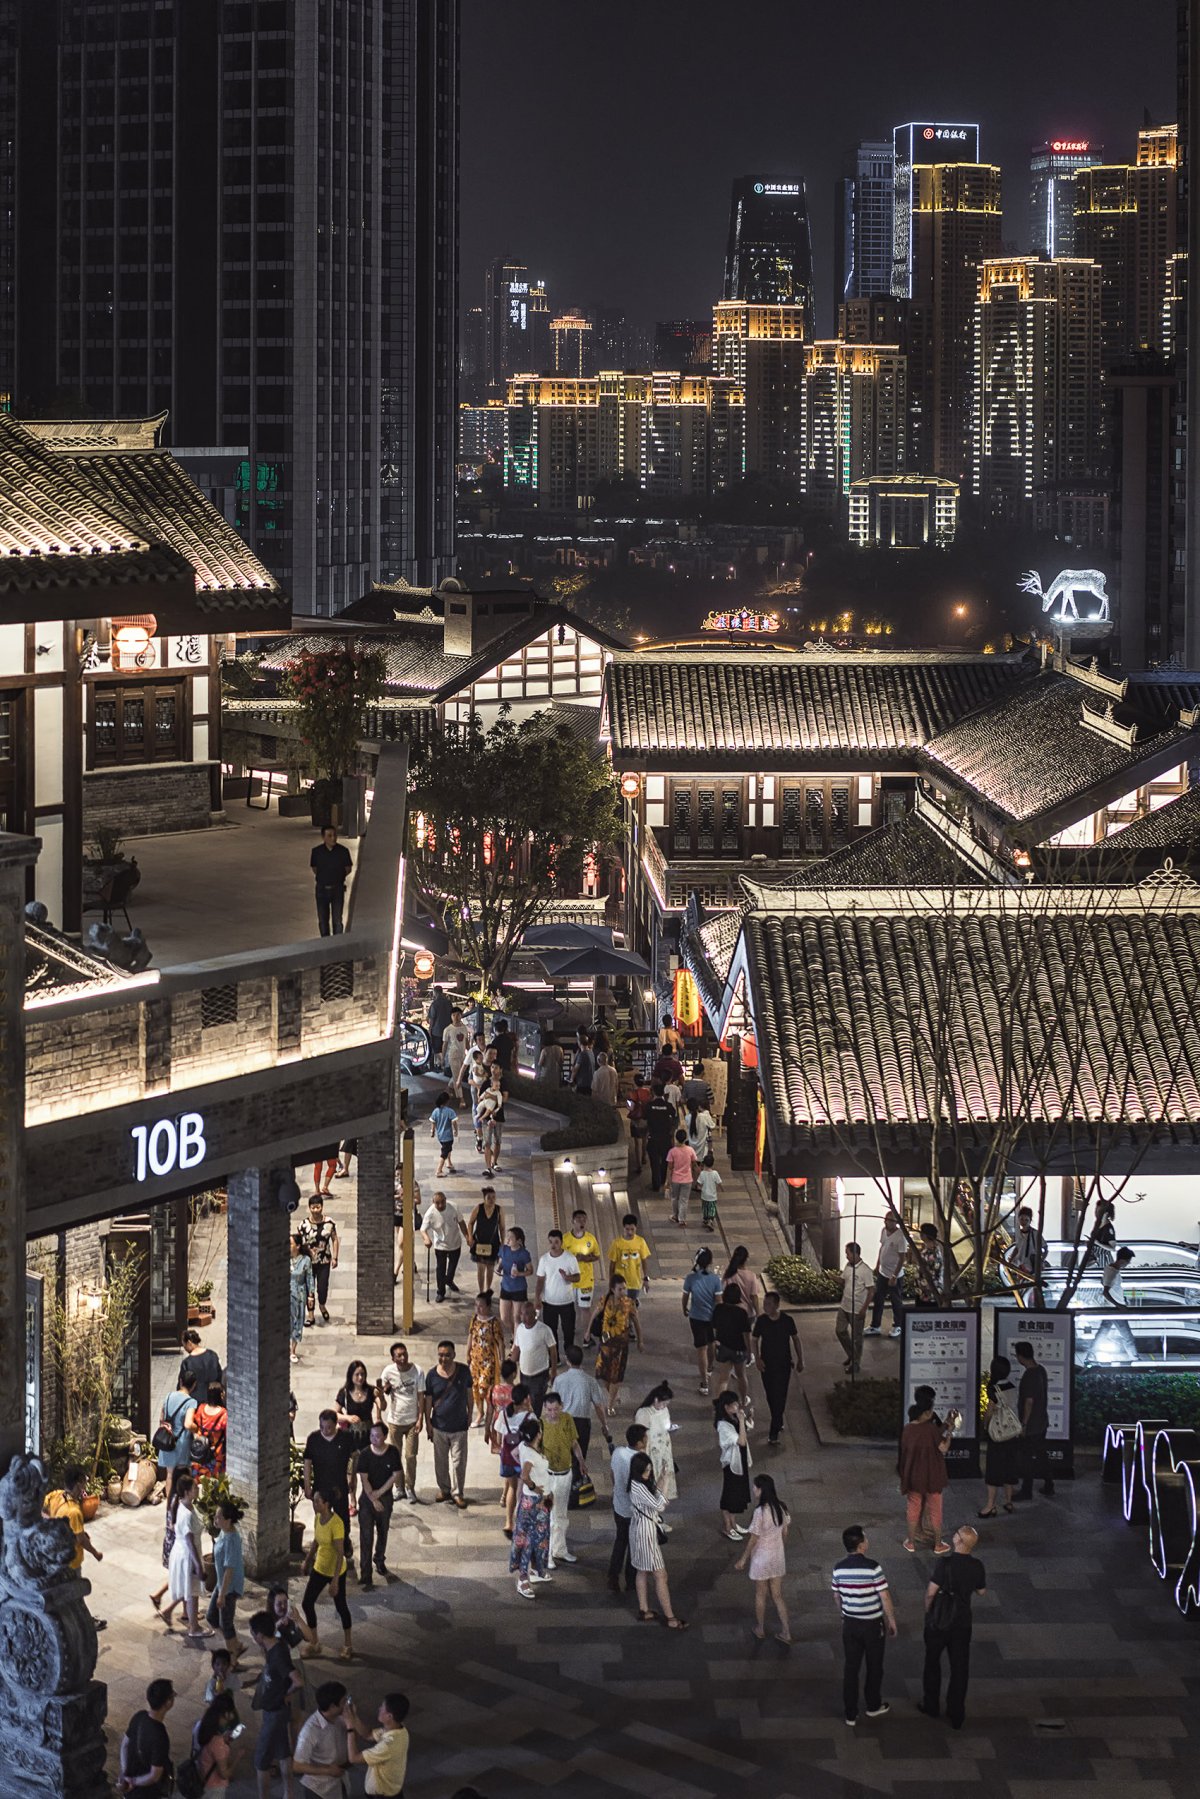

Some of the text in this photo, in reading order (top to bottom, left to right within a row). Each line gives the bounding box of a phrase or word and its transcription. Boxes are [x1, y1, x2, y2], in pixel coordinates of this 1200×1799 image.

[935, 128, 967, 140] 中国银行
[131, 1112, 206, 1182] 10B
